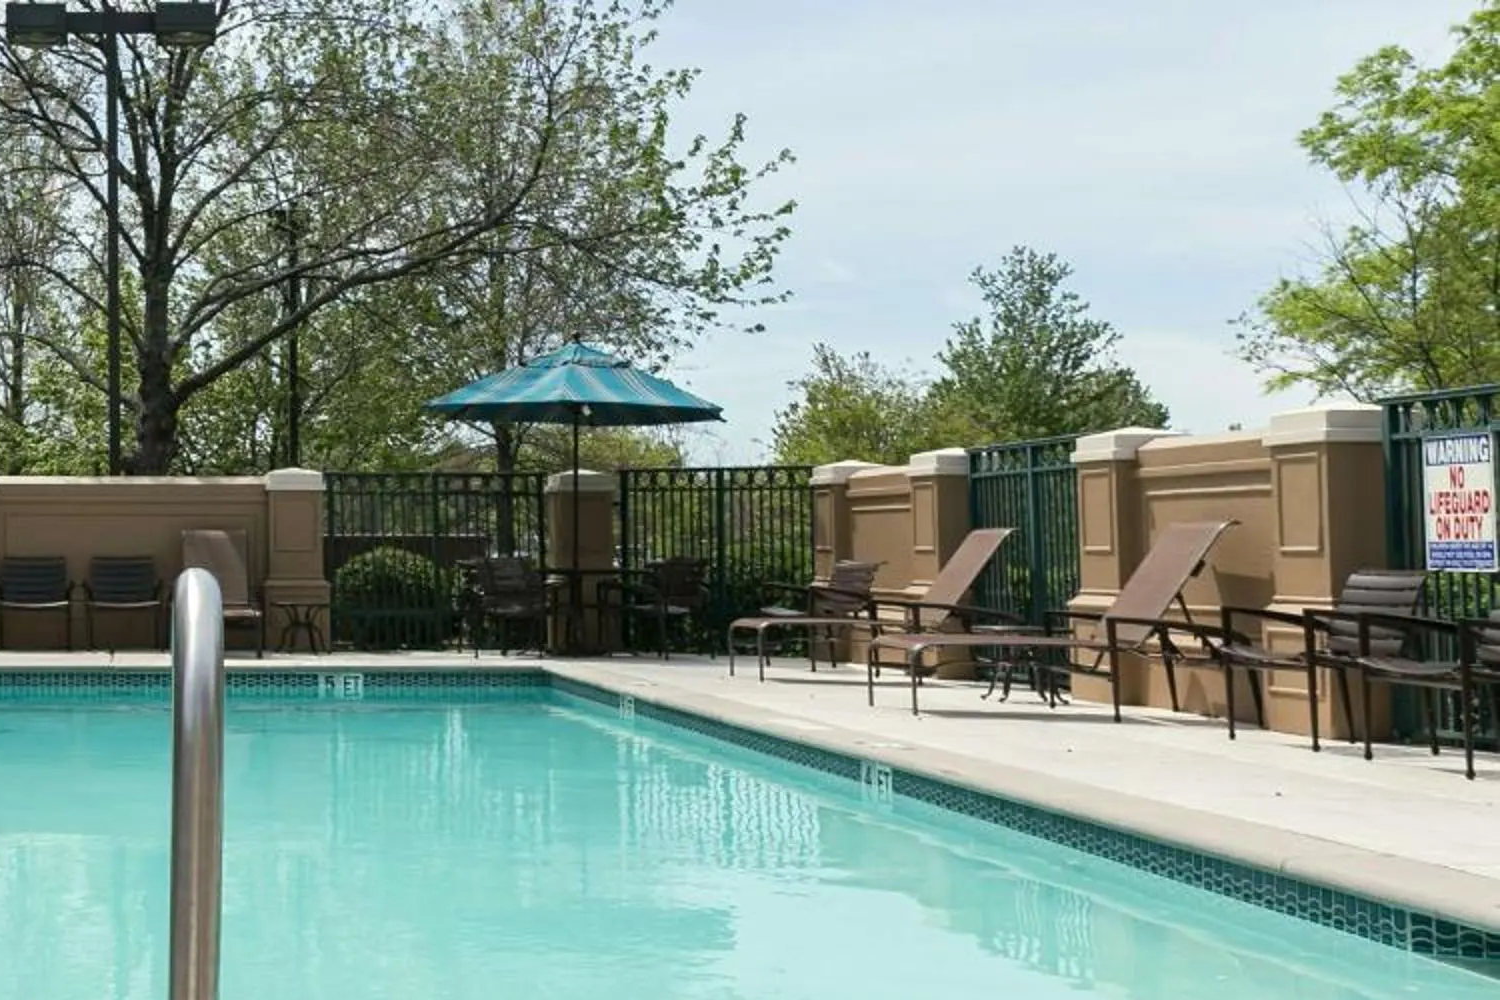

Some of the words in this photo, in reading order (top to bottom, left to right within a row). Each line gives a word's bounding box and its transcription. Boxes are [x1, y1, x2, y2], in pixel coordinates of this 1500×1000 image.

[1426, 437, 1489, 464] WARNING
[1449, 465, 1465, 489] NO
[1430, 490, 1490, 514] LIFEGUARD
[1436, 516, 1451, 539] ON
[1453, 516, 1483, 539] DUTY
